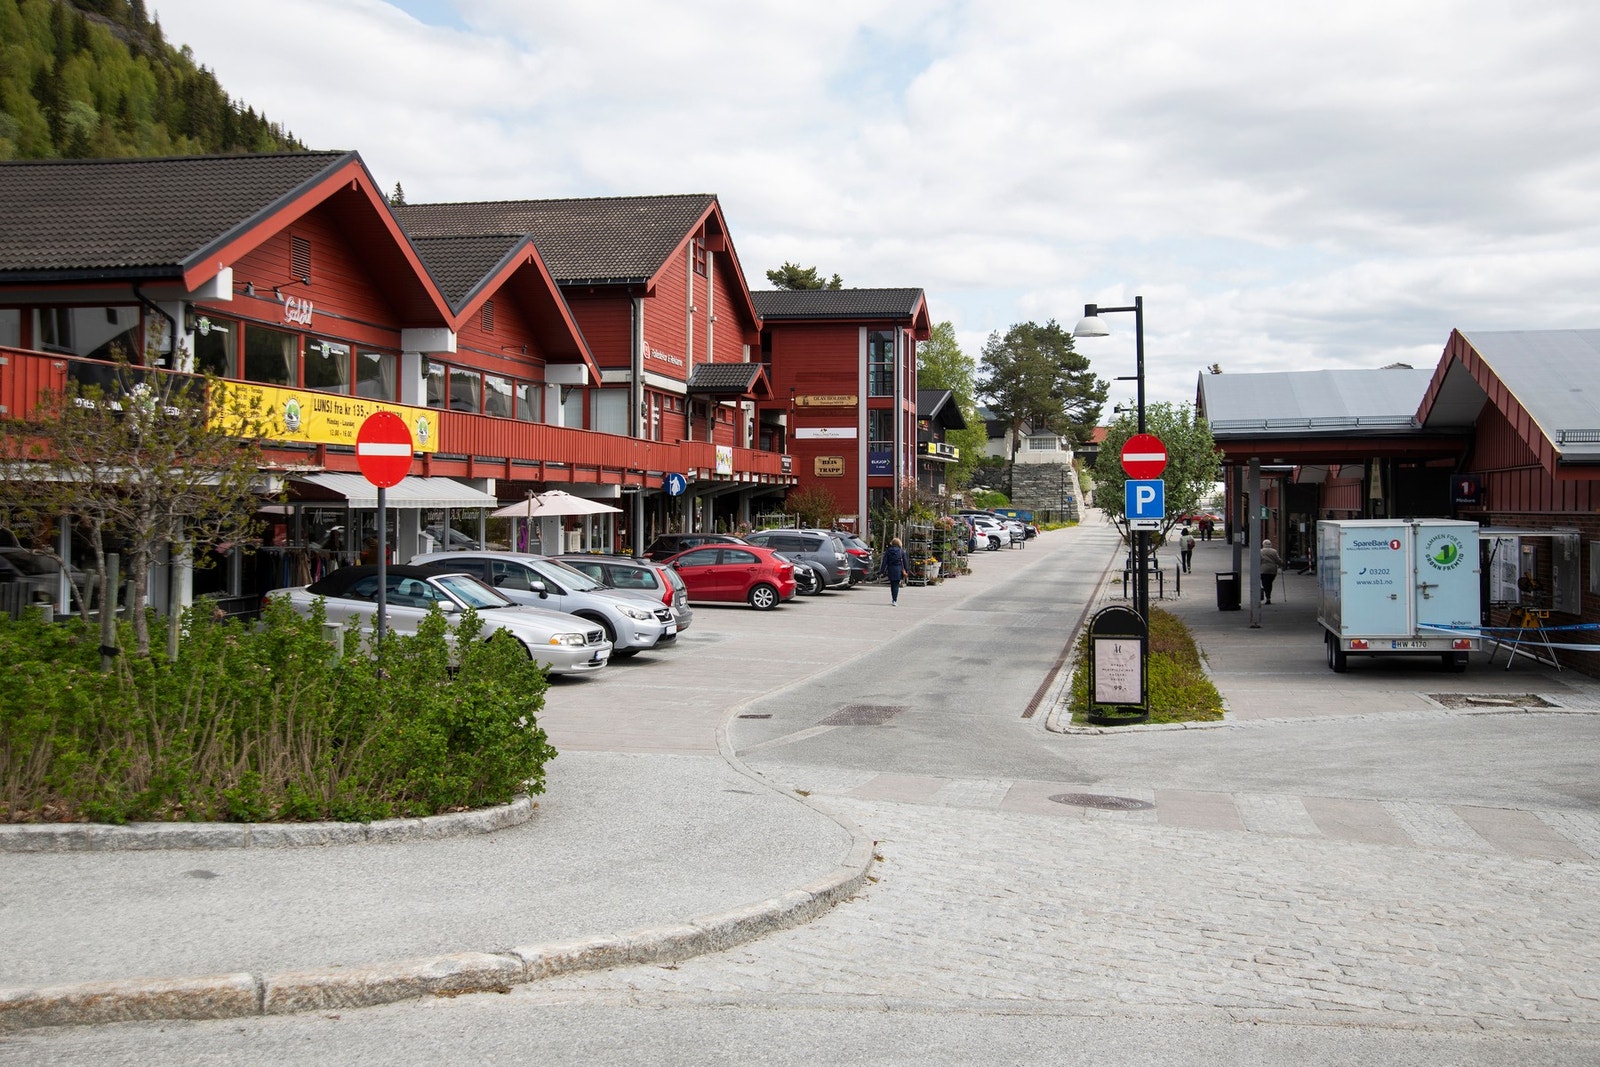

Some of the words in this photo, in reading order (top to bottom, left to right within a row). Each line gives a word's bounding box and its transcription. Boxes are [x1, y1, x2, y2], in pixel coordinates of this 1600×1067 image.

[314, 398, 332, 413] LUNSJ
[334, 402, 342, 414] fra
[344, 402, 350, 416] kr
[352, 404, 369, 418] 135,-
[1462, 482, 1469, 494] 1
[1136, 486, 1156, 514] P
[1426, 534, 1446, 550] SAMMEN
[1446, 534, 1458, 542] FOR
[1456, 540, 1464, 550] EN
[1440, 544, 1450, 560] 1
[1425, 553, 1442, 570] GRØNN
[1442, 553, 1464, 571] FREMTID
